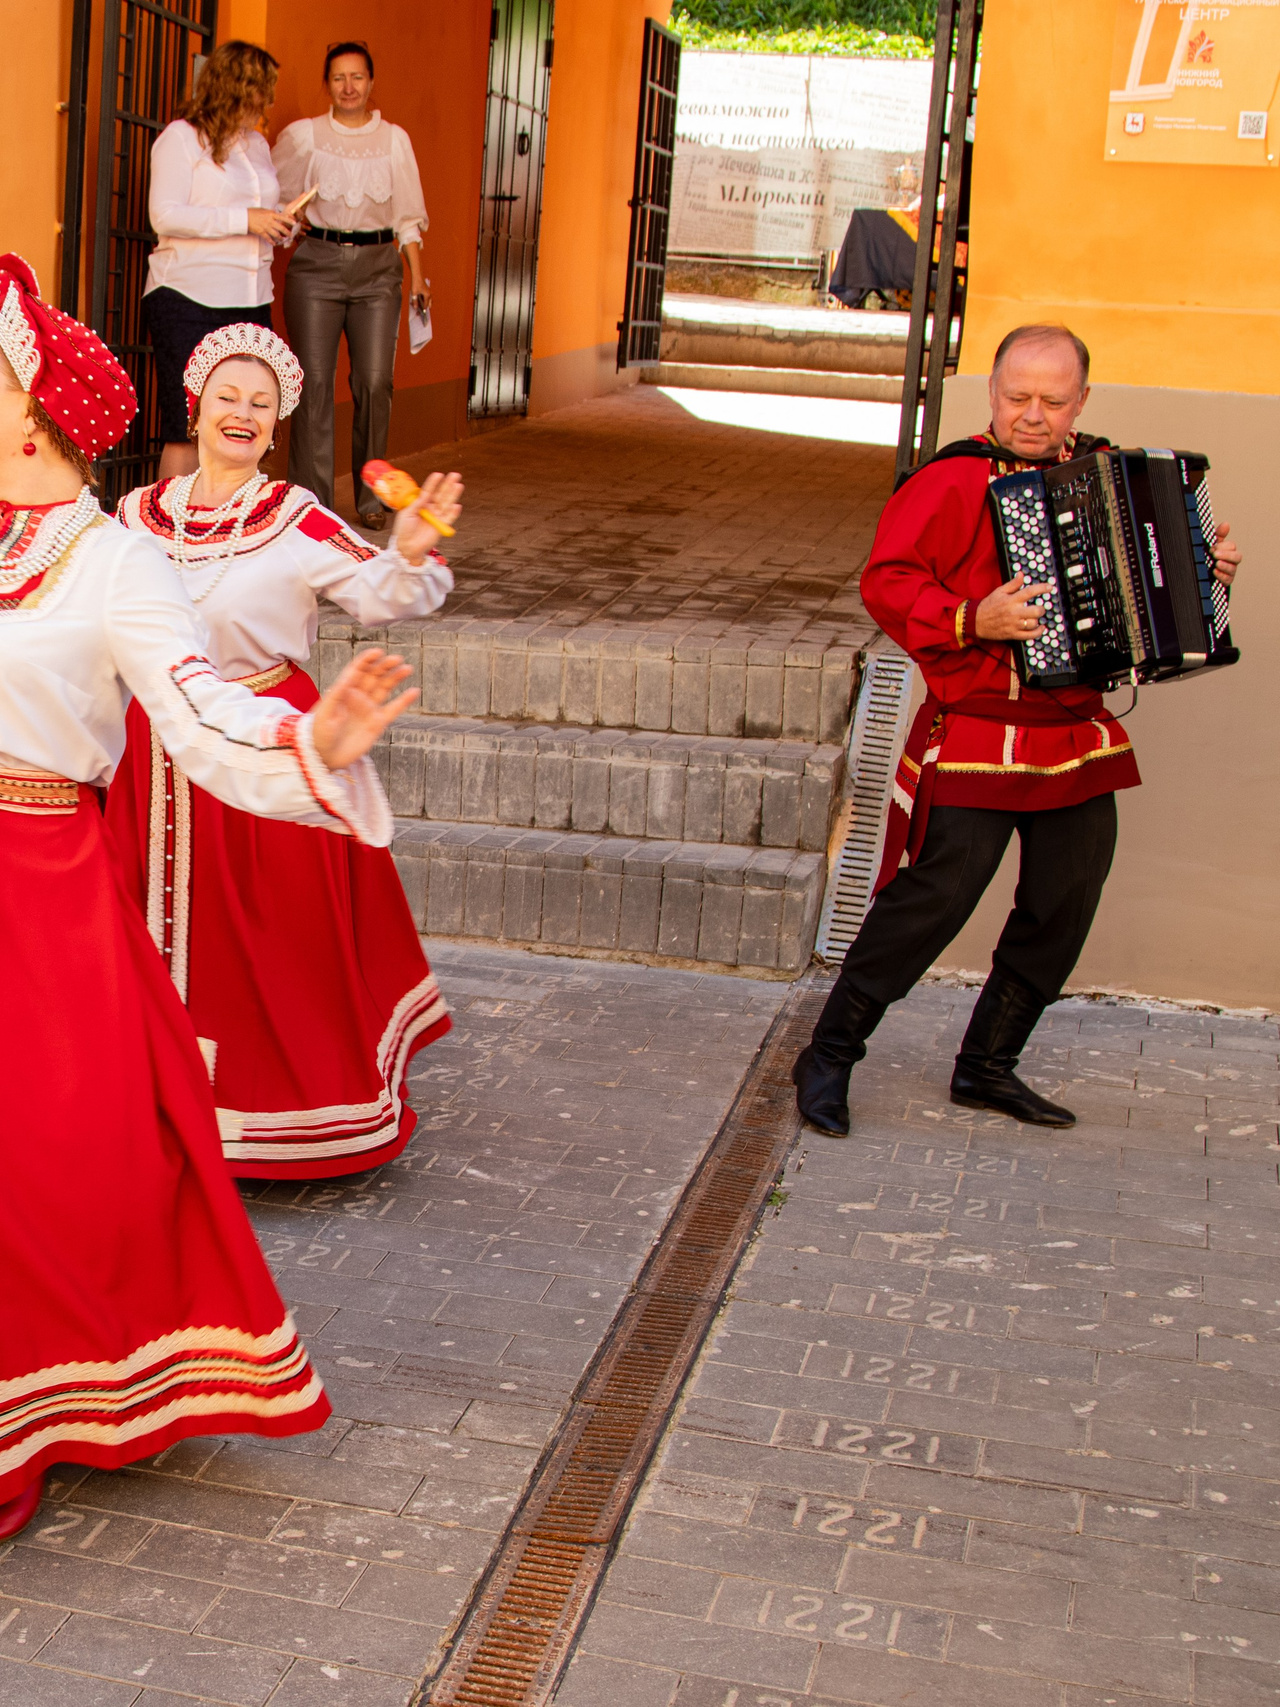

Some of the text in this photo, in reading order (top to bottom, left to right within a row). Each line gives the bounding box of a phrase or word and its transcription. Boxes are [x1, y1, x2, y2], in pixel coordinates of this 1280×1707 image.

[1180, 8, 1230, 21] ЦЕНТР
[1175, 78, 1223, 89] НОВГОРОД
[1177, 68, 1220, 78] НИЖНИЙ
[678, 102, 790, 119] евозможно
[675, 132, 724, 145] мысл
[720, 184, 826, 208] М.Горький
[1144, 522, 1161, 569] Roland
[924, 1148, 1018, 1175] 1221
[908, 1191, 1009, 1221] 1221
[266, 1239, 352, 1271] 221
[865, 1293, 976, 1330] 1221
[841, 1351, 959, 1393] 1221
[814, 1419, 939, 1464] 1221
[35, 1510, 110, 1550] 21
[792, 1496, 927, 1549] 1221
[757, 1589, 903, 1643] 1221
